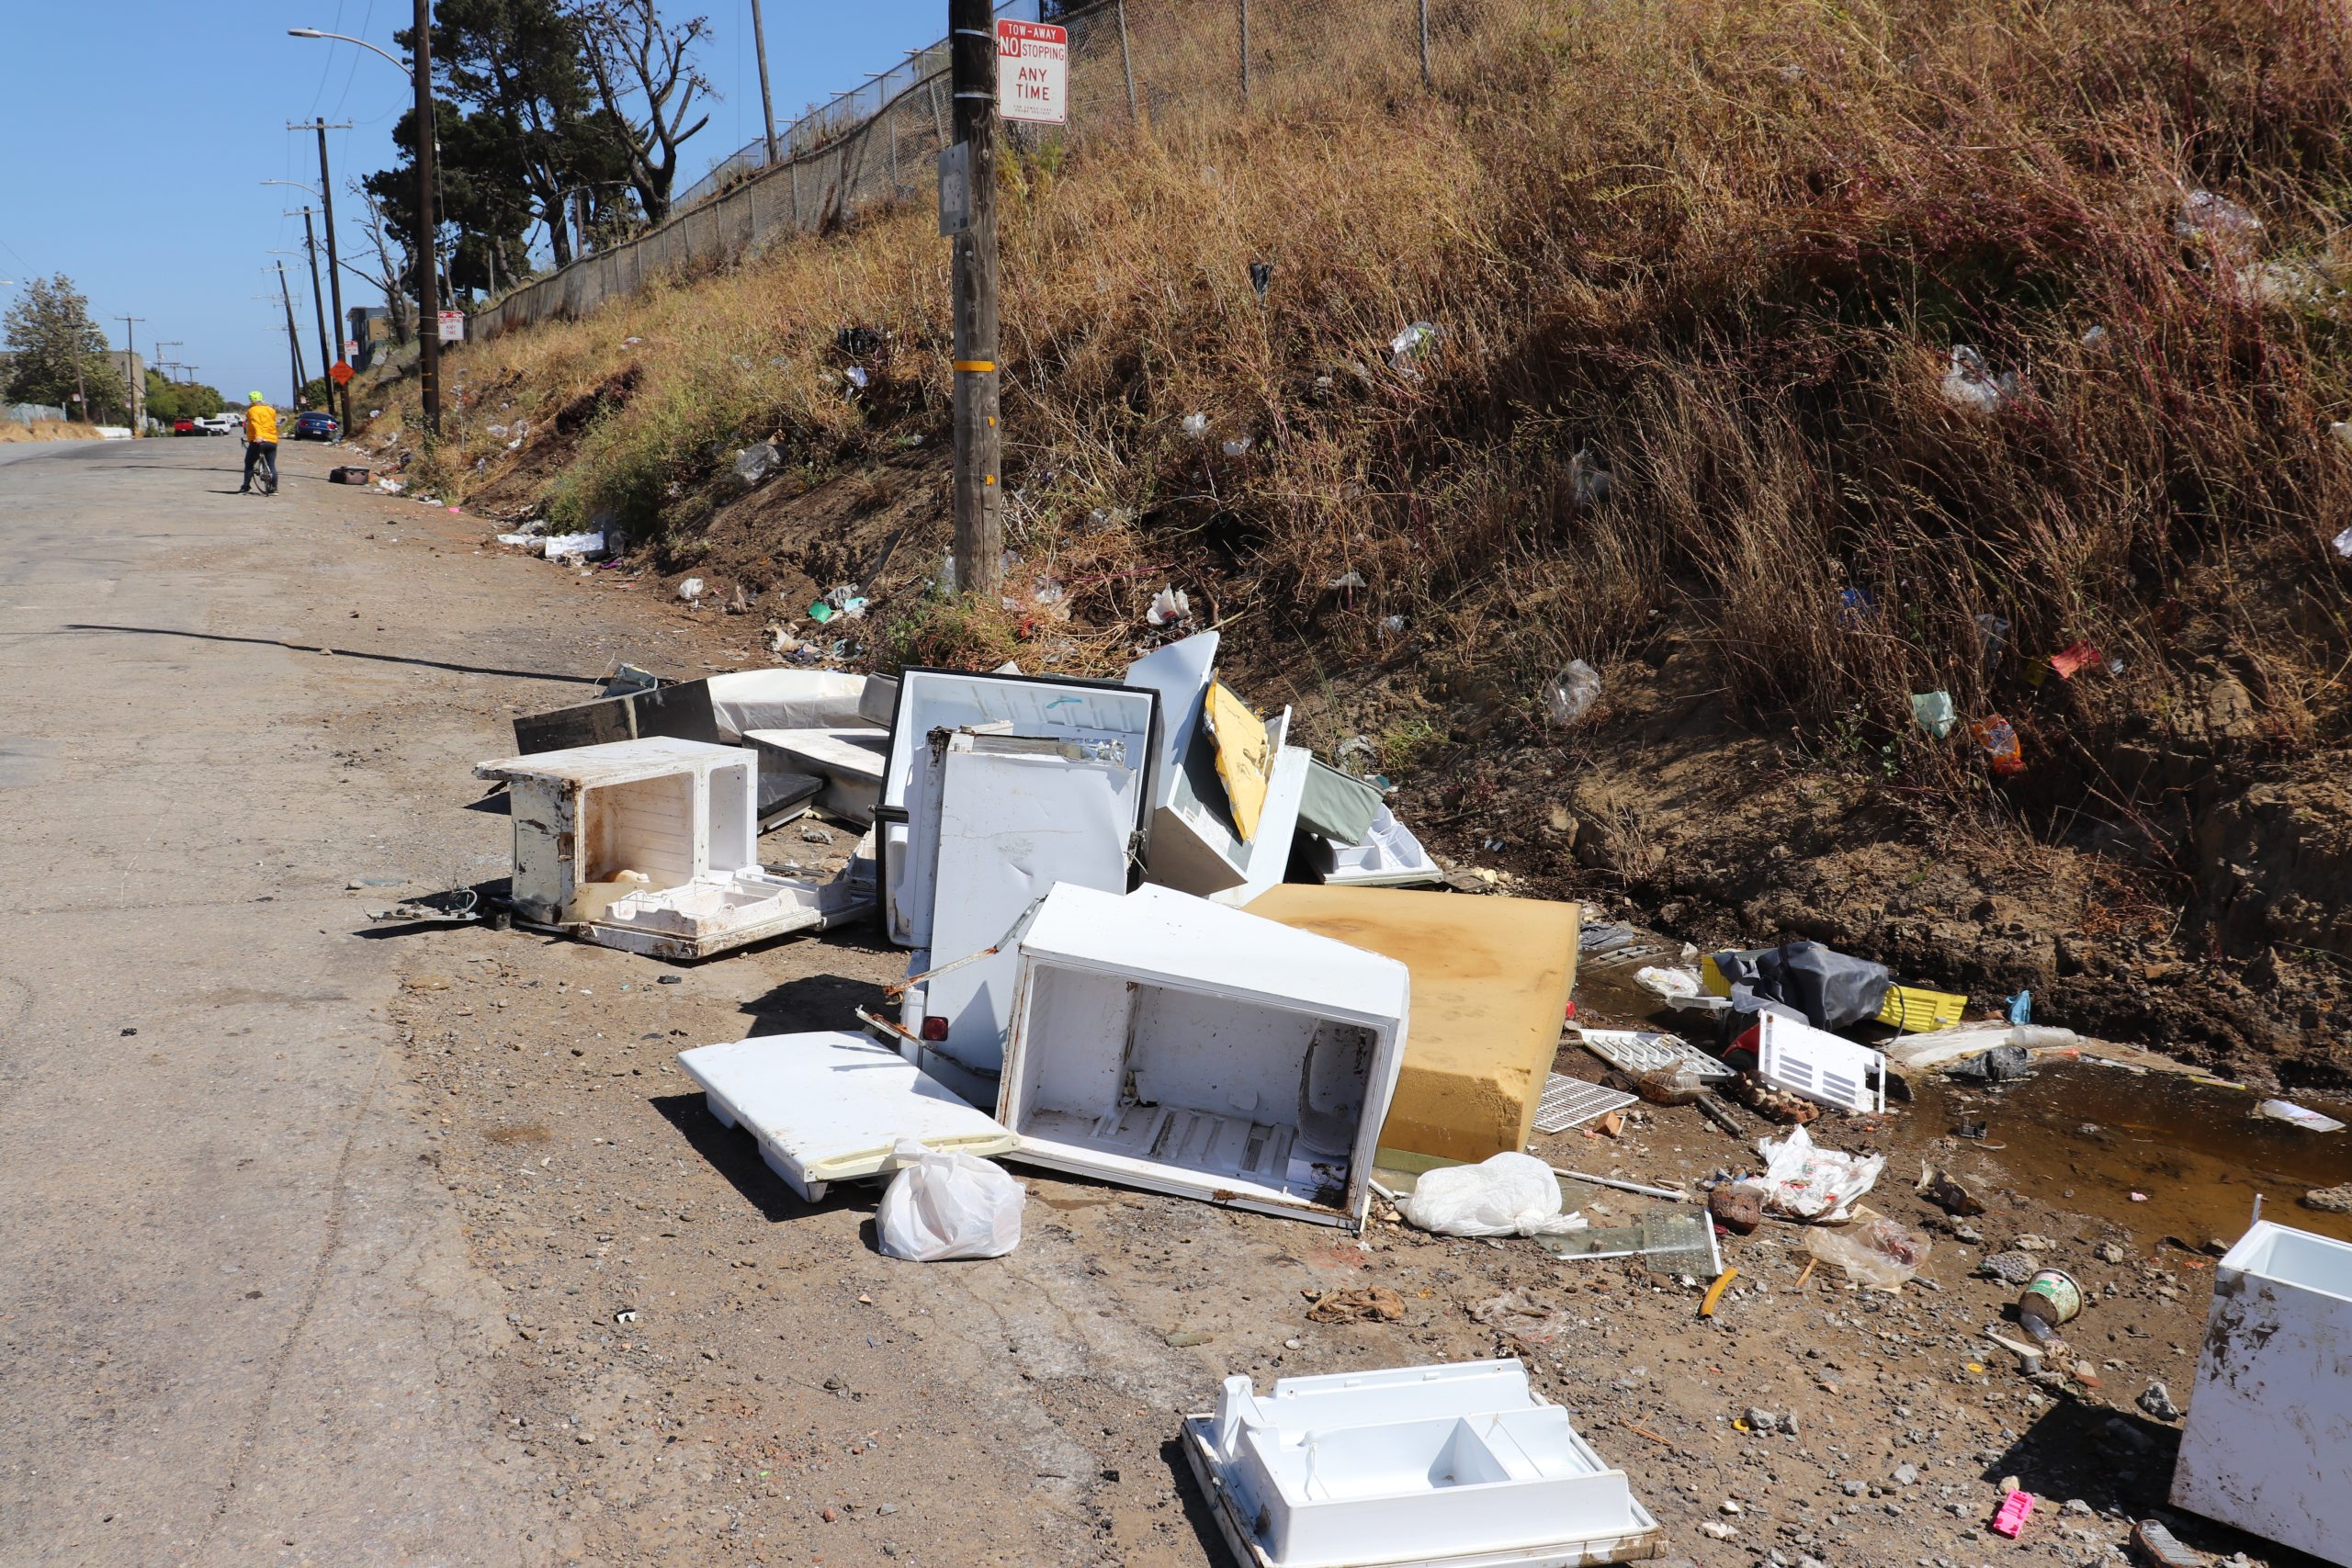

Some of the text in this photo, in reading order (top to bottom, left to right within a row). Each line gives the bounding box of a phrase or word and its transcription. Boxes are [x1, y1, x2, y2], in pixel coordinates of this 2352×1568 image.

[1008, 24, 1057, 39] TOW-AWAY
[1000, 36, 1065, 61] NO STOPPING
[1018, 66, 1047, 82] ANY
[1016, 83, 1050, 101] TIME
